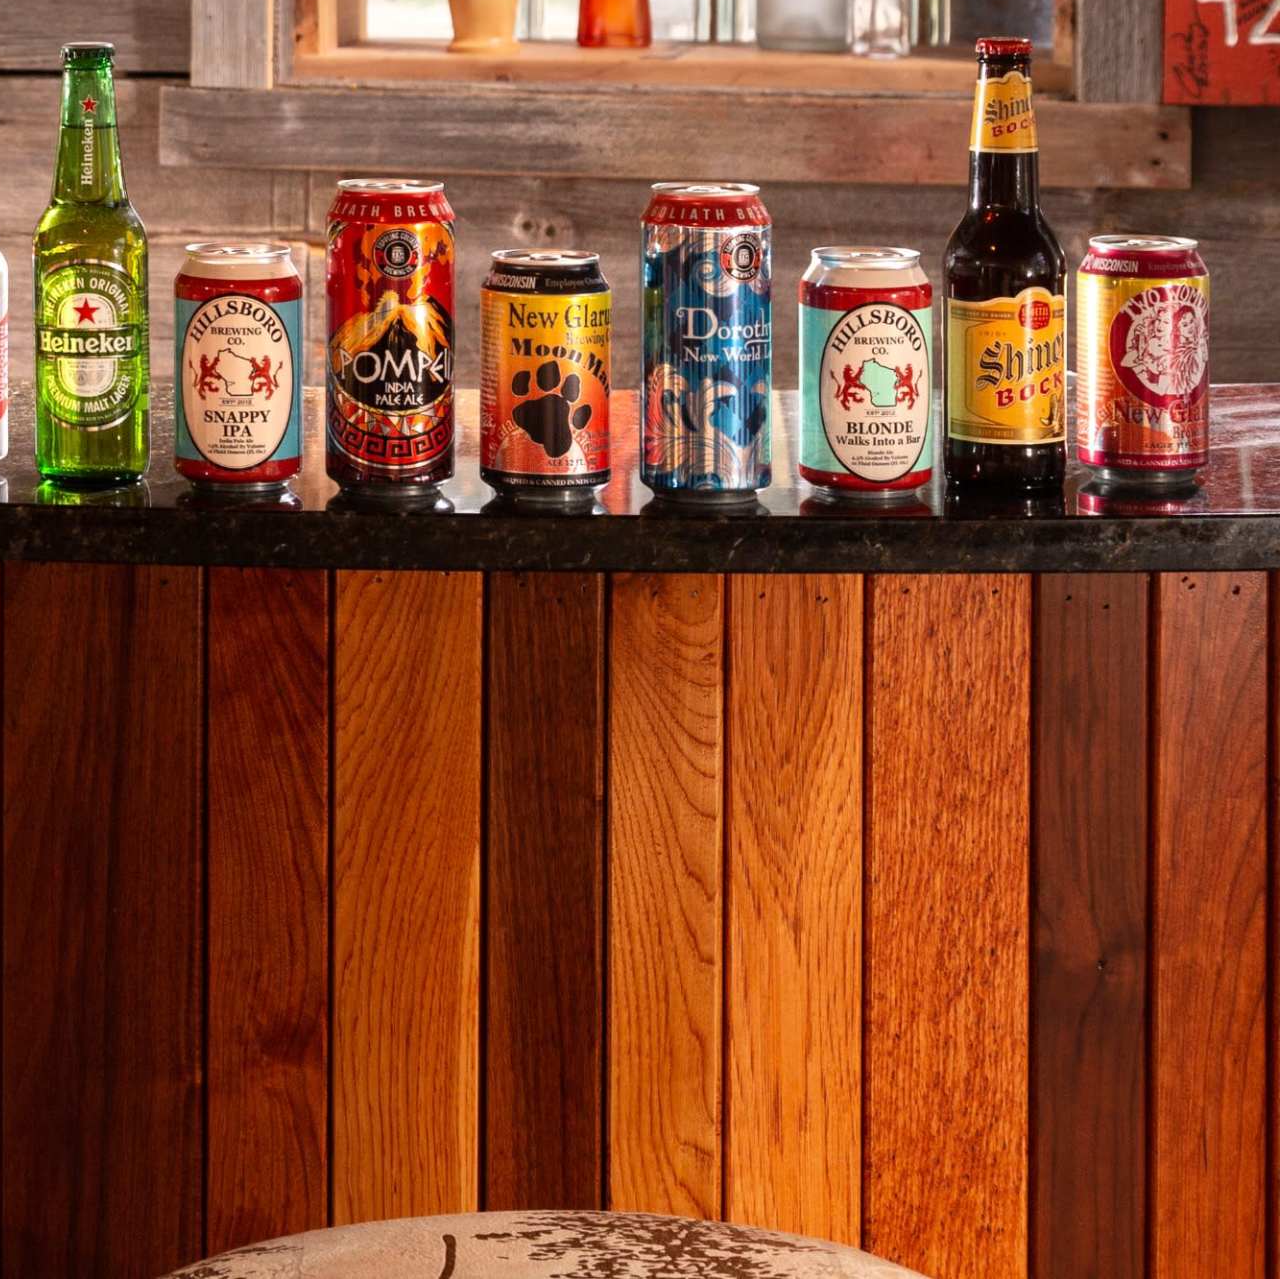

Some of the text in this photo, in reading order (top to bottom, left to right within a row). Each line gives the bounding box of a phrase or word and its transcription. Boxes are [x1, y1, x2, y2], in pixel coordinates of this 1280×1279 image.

[985, 97, 1031, 124] Shin
[81, 119, 93, 186] Heineken
[1092, 257, 1139, 273] WISCONSIN
[493, 273, 536, 289] WISCONSIN
[44, 277, 130, 318] HEINEKEN ORIGINAL
[1120, 288, 1160, 319] TWO
[190, 300, 284, 345] HILLSBORO
[509, 303, 610, 329] New Glaru
[211, 326, 263, 337] BREWING
[832, 309, 922, 354] HILLSBORO
[853, 335, 905, 346] BREWING
[227, 336, 246, 347] CO.
[511, 337, 582, 363] Moon
[683, 345, 720, 363] New
[722, 343, 761, 363] World
[871, 347, 889, 356] CO.
[340, 348, 450, 384] POMPEII
[84, 398, 110, 413] MALT
[109, 374, 131, 404] LAGER
[384, 381, 415, 393] INDIA
[995, 370, 1062, 407] BOCK
[375, 394, 424, 406] PALE ALE
[204, 410, 271, 424] SNAPPY
[1115, 400, 1162, 426] New
[222, 425, 253, 438] IPA
[846, 421, 914, 435] BLONDE
[836, 434, 921, 447] Walks Into a Bar
[536, 478, 567, 487] CANNED
